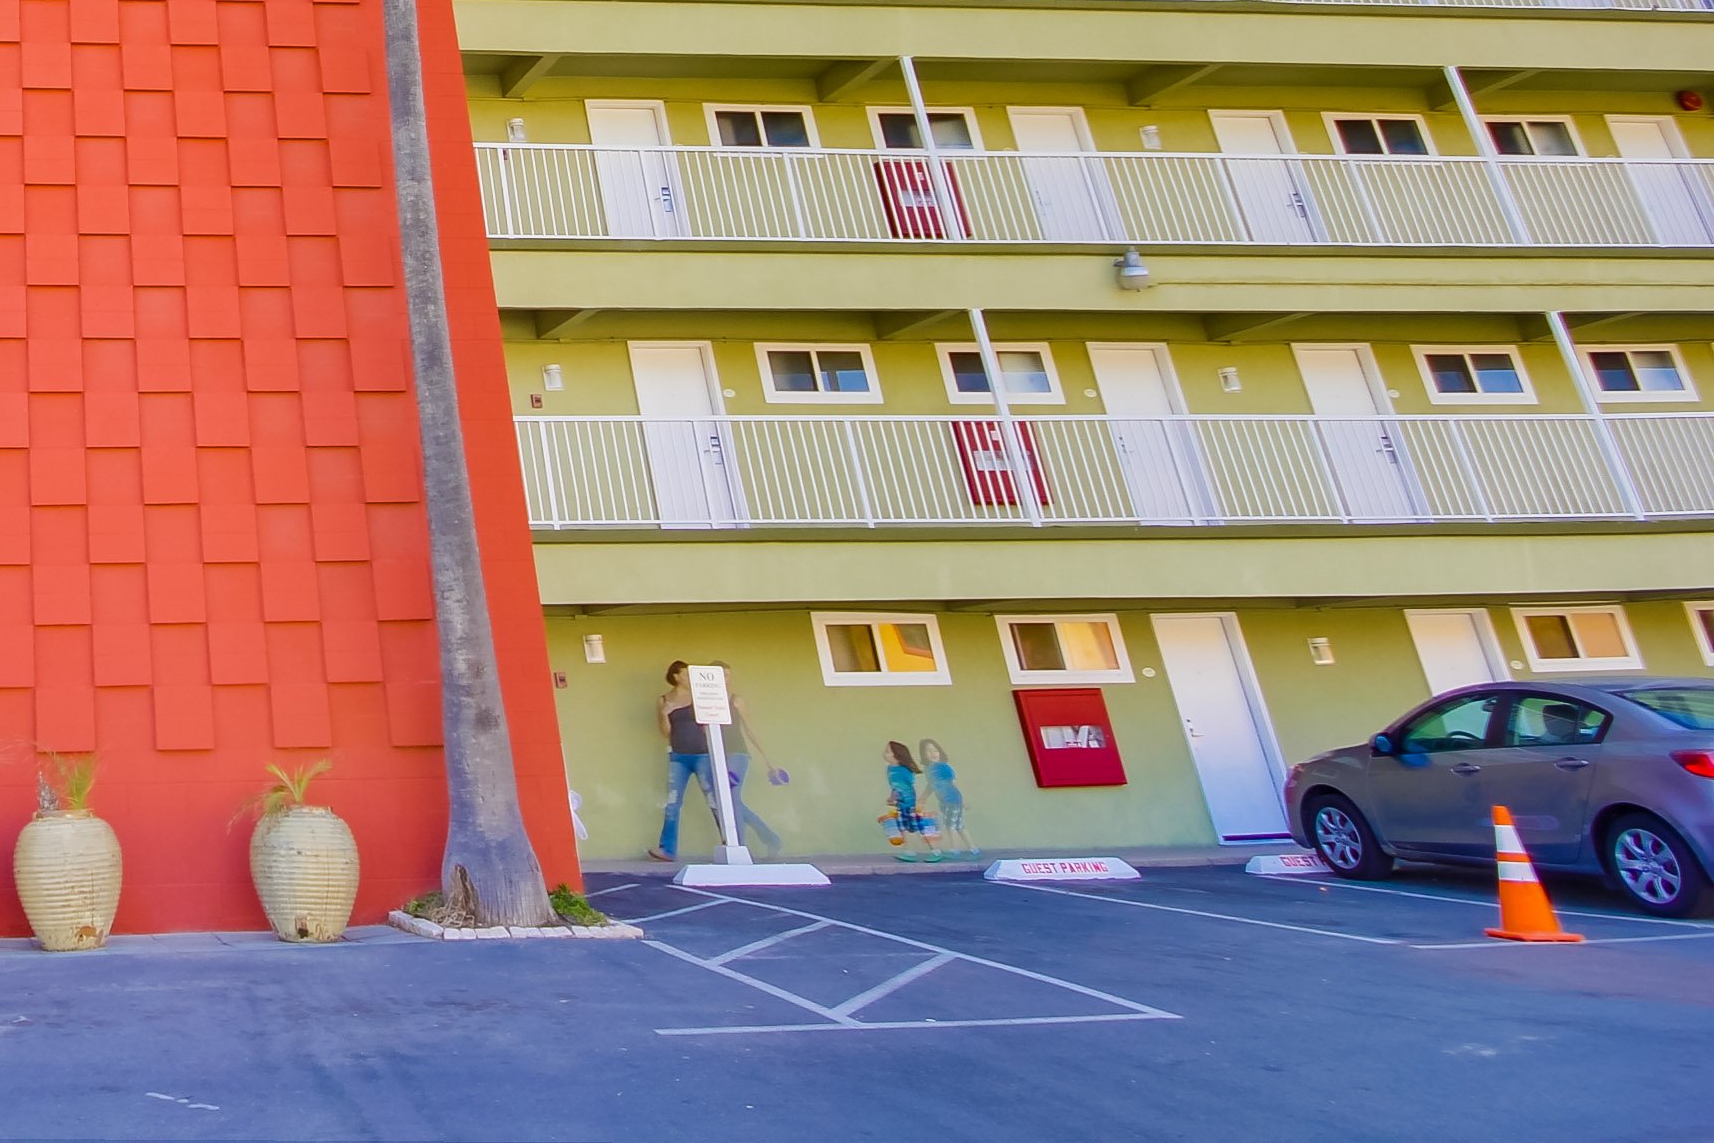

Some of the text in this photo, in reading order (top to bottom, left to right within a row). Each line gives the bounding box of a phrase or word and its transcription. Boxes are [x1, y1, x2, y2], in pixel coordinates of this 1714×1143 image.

[699, 672, 715, 682] NO
[1279, 856, 1319, 867] GUEST
[1021, 861, 1110, 875] GUEST PARKING
